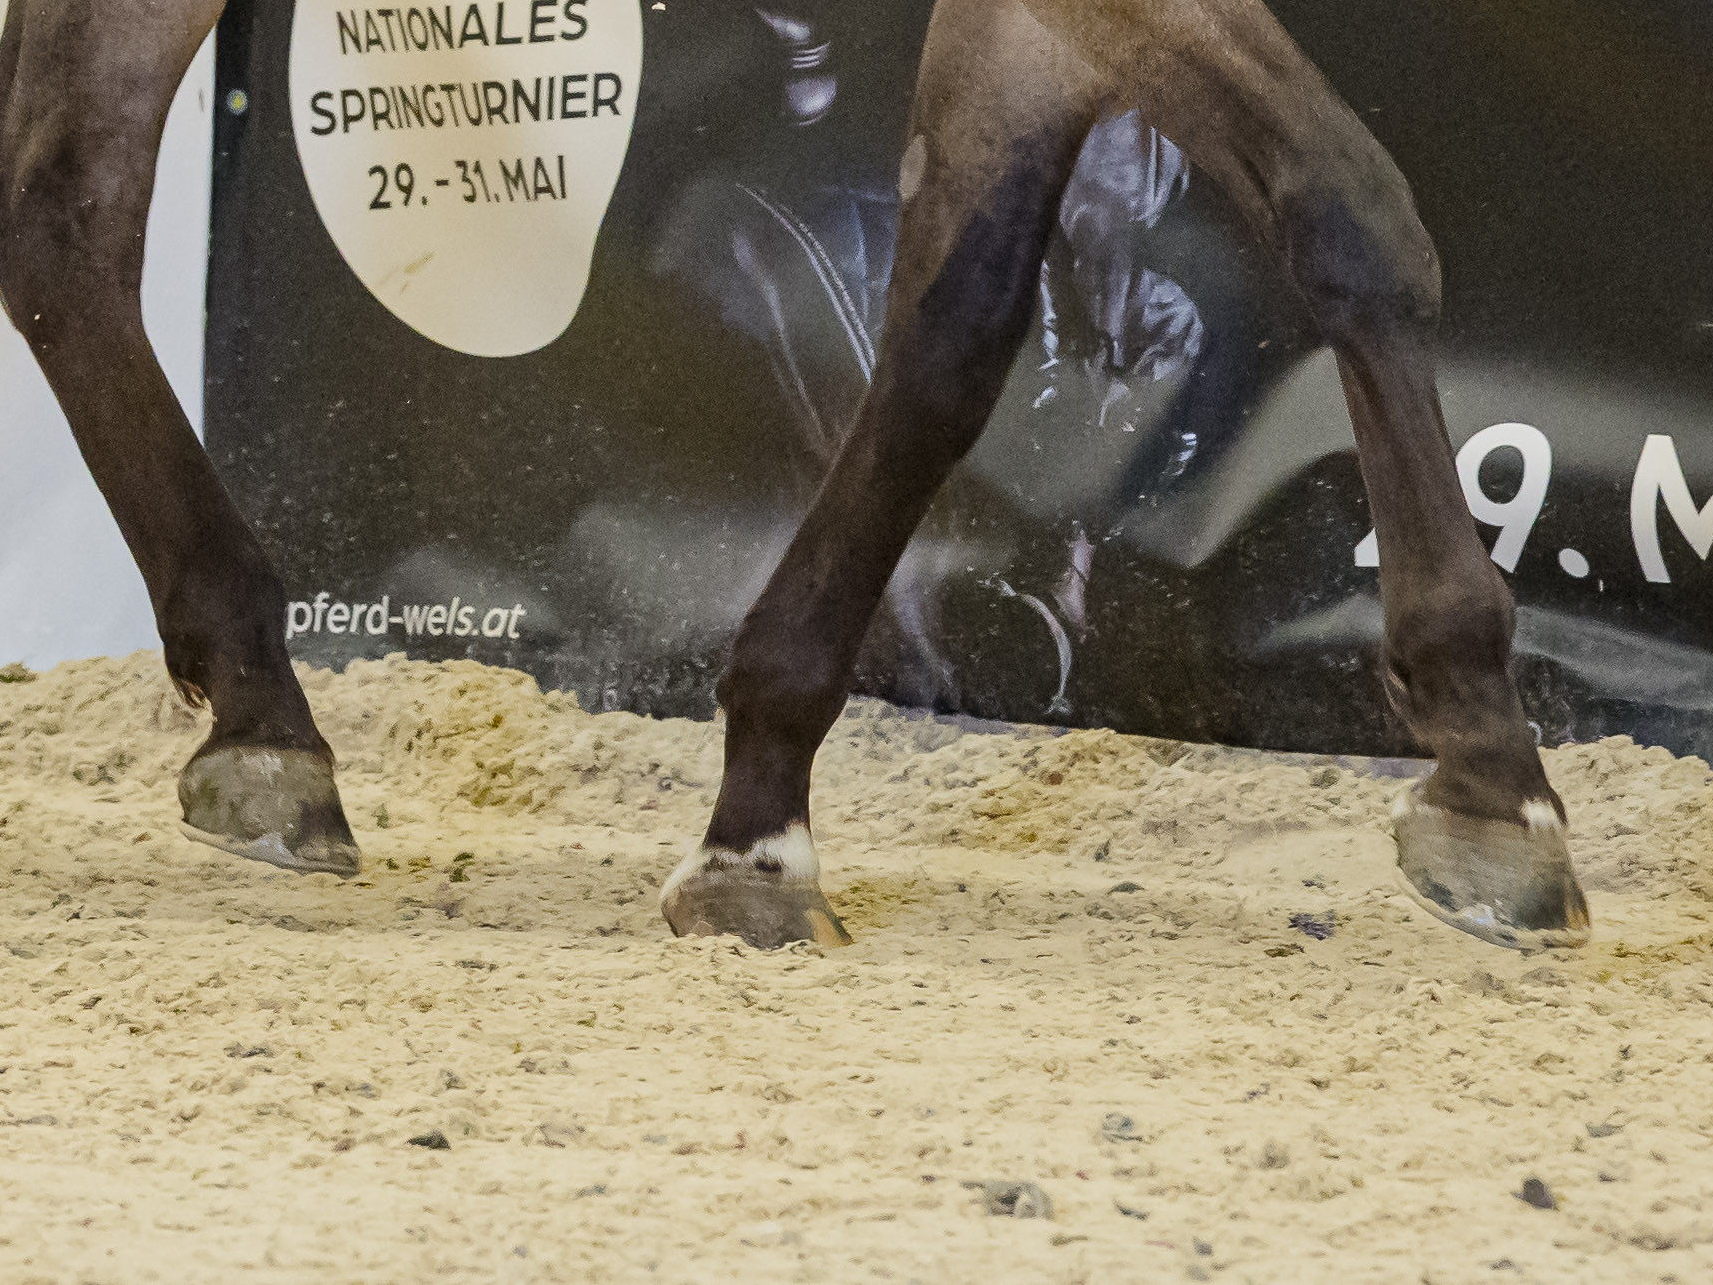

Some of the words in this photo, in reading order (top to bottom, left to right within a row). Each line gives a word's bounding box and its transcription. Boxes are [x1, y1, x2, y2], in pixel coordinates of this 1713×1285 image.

[310, 72, 622, 136] SPRINGTURNIER
[1353, 421, 1590, 579] 9.
[285, 591, 527, 643] pferd-wels.at
